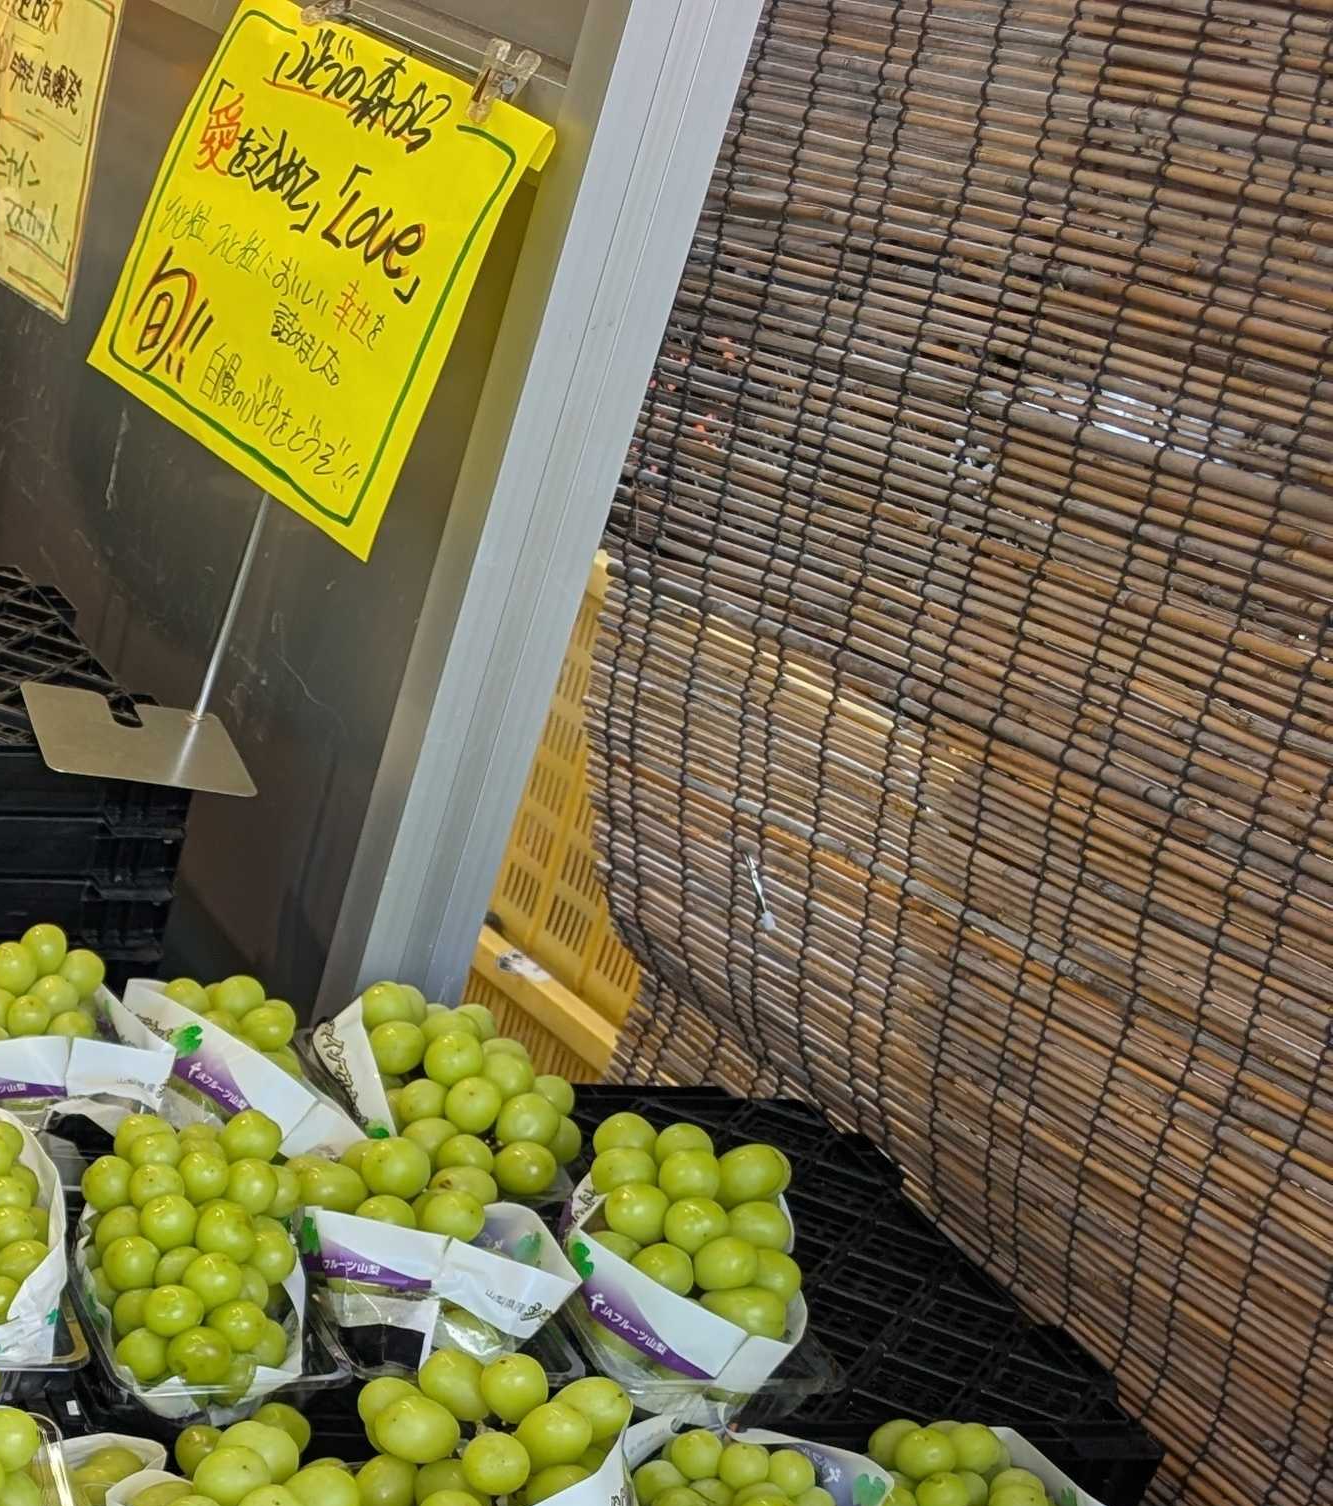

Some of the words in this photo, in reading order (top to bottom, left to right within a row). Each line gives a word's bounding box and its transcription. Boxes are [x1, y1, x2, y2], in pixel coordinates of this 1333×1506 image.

[600, 1306, 669, 1357] JAフルーツ山梨
